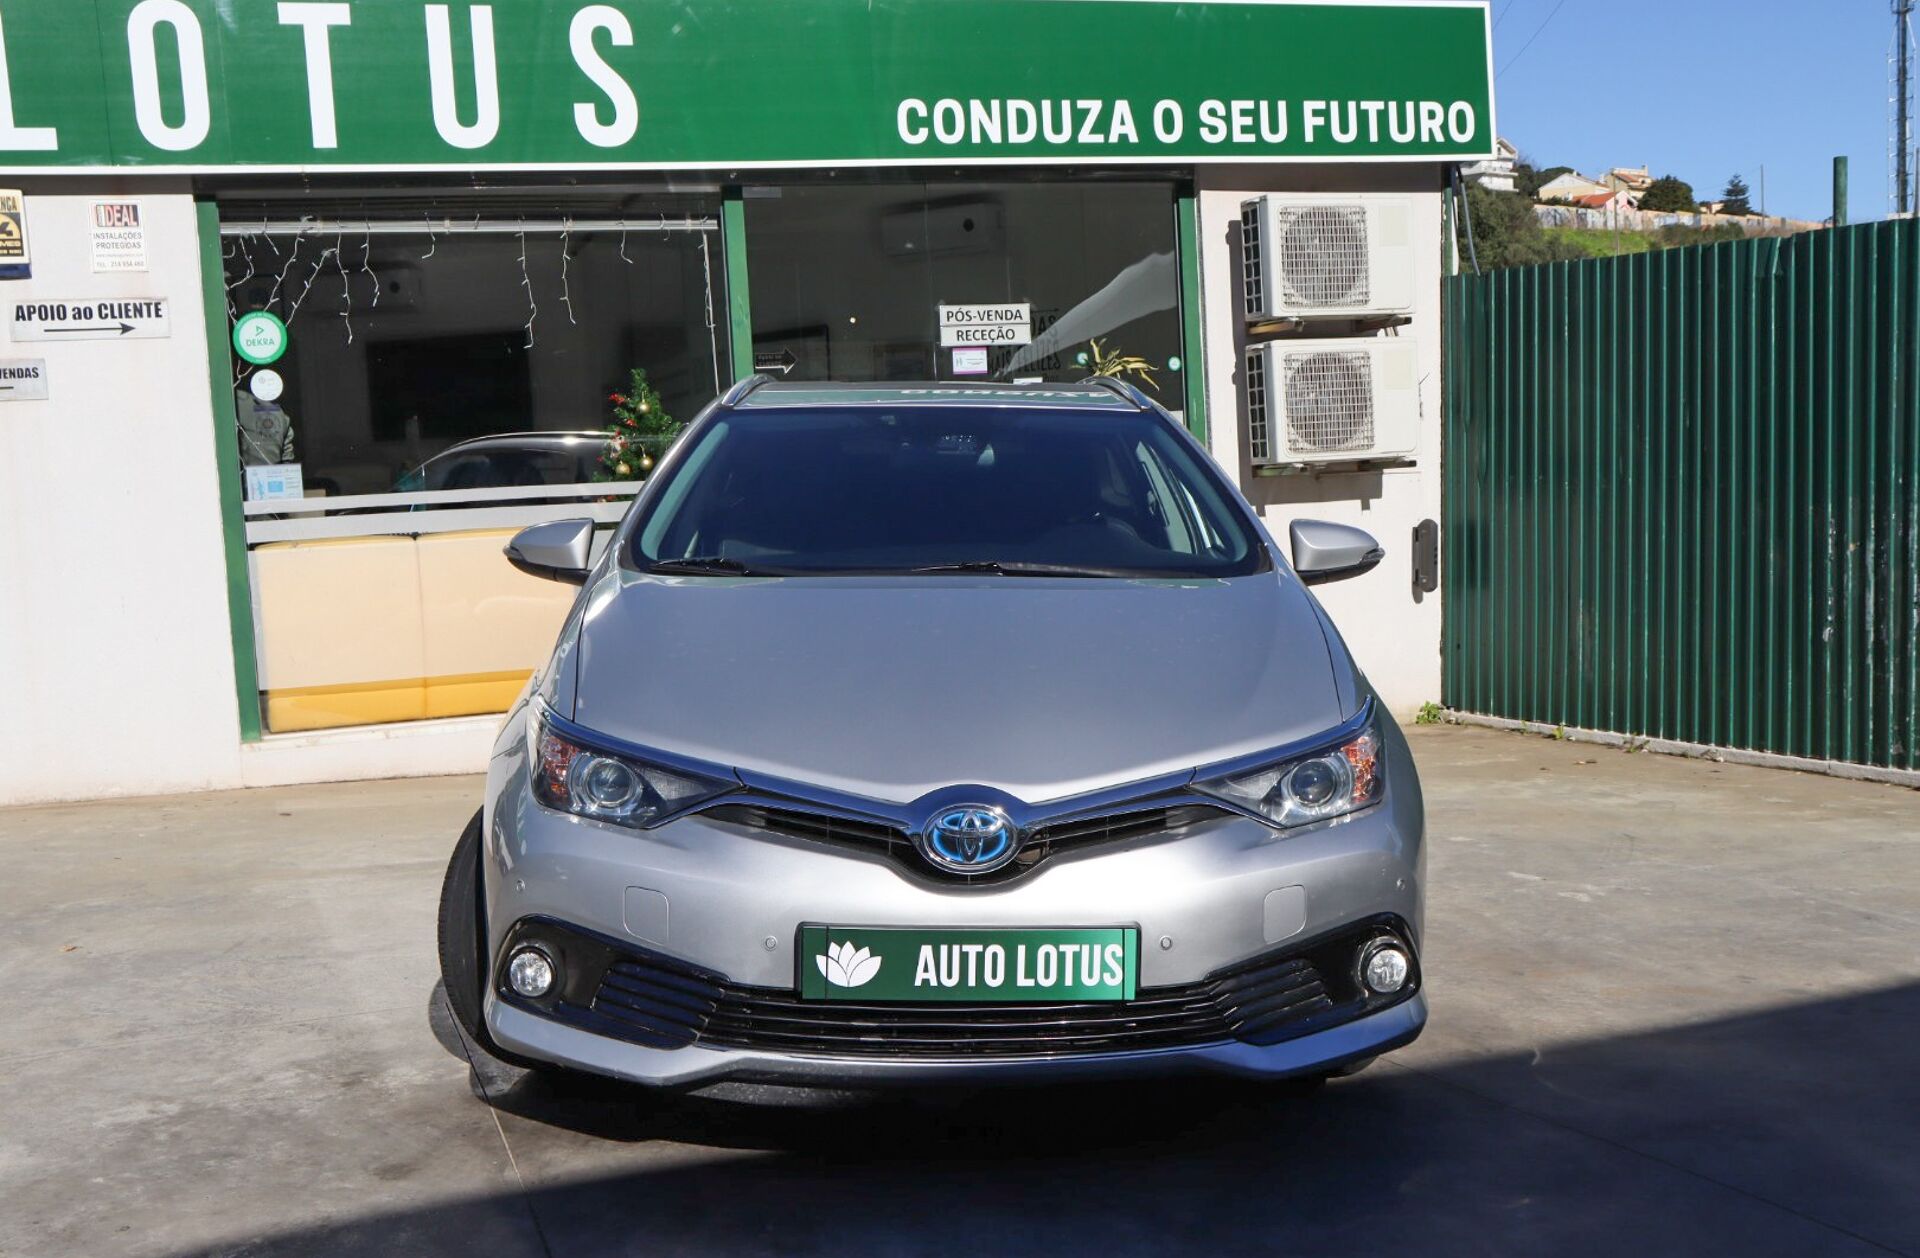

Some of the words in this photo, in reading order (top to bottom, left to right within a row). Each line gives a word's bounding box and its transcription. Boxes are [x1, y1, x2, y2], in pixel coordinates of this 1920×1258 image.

[896, 98, 1140, 145] CONDUZA
[1152, 98, 1185, 145] O
[1198, 99, 1289, 144] SEU
[1303, 100, 1476, 144] FUTURO
[97, 205, 139, 227] IDEAL
[96, 242, 142, 250] PROTEGIDAS
[15, 303, 67, 322] APOIO
[72, 305, 93, 321] ao
[97, 301, 163, 320] CLIENTE
[946, 307, 1023, 322] PÓS-VENDA
[246, 337, 275, 347] DEKRA
[956, 326, 1016, 343] RECEÇÃO
[914, 944, 1005, 988] AUTO
[1016, 944, 1124, 988] LOTUS
